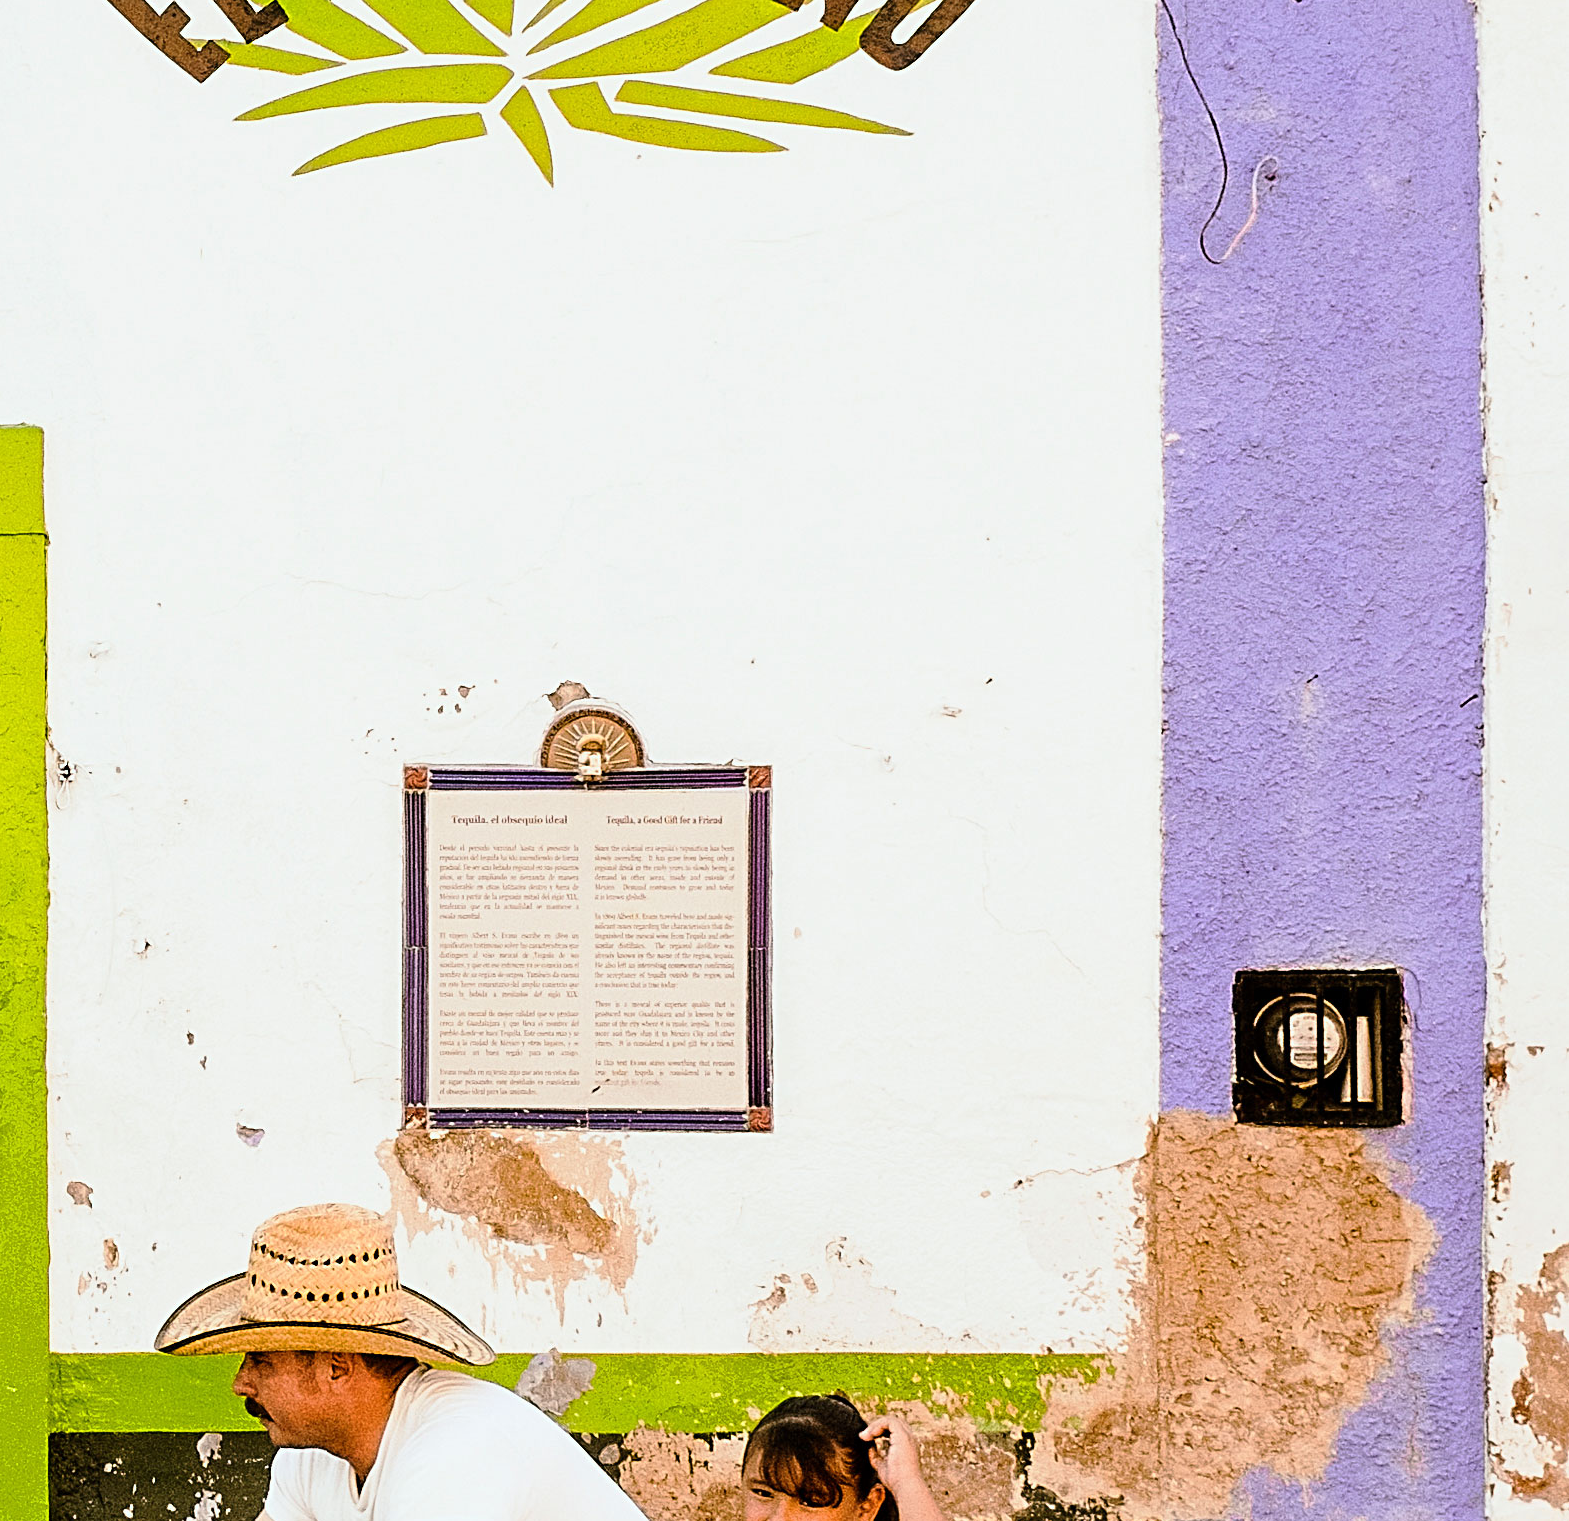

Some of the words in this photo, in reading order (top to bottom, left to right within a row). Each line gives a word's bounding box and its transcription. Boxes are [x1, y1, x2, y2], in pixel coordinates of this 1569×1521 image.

[491, 815, 499, 824] el
[501, 815, 543, 826] obsequio
[545, 815, 568, 824] ideal
[643, 815, 662, 824] Good
[664, 815, 678, 824] Gift
[679, 815, 690, 824] for
[698, 815, 723, 824] Friend
